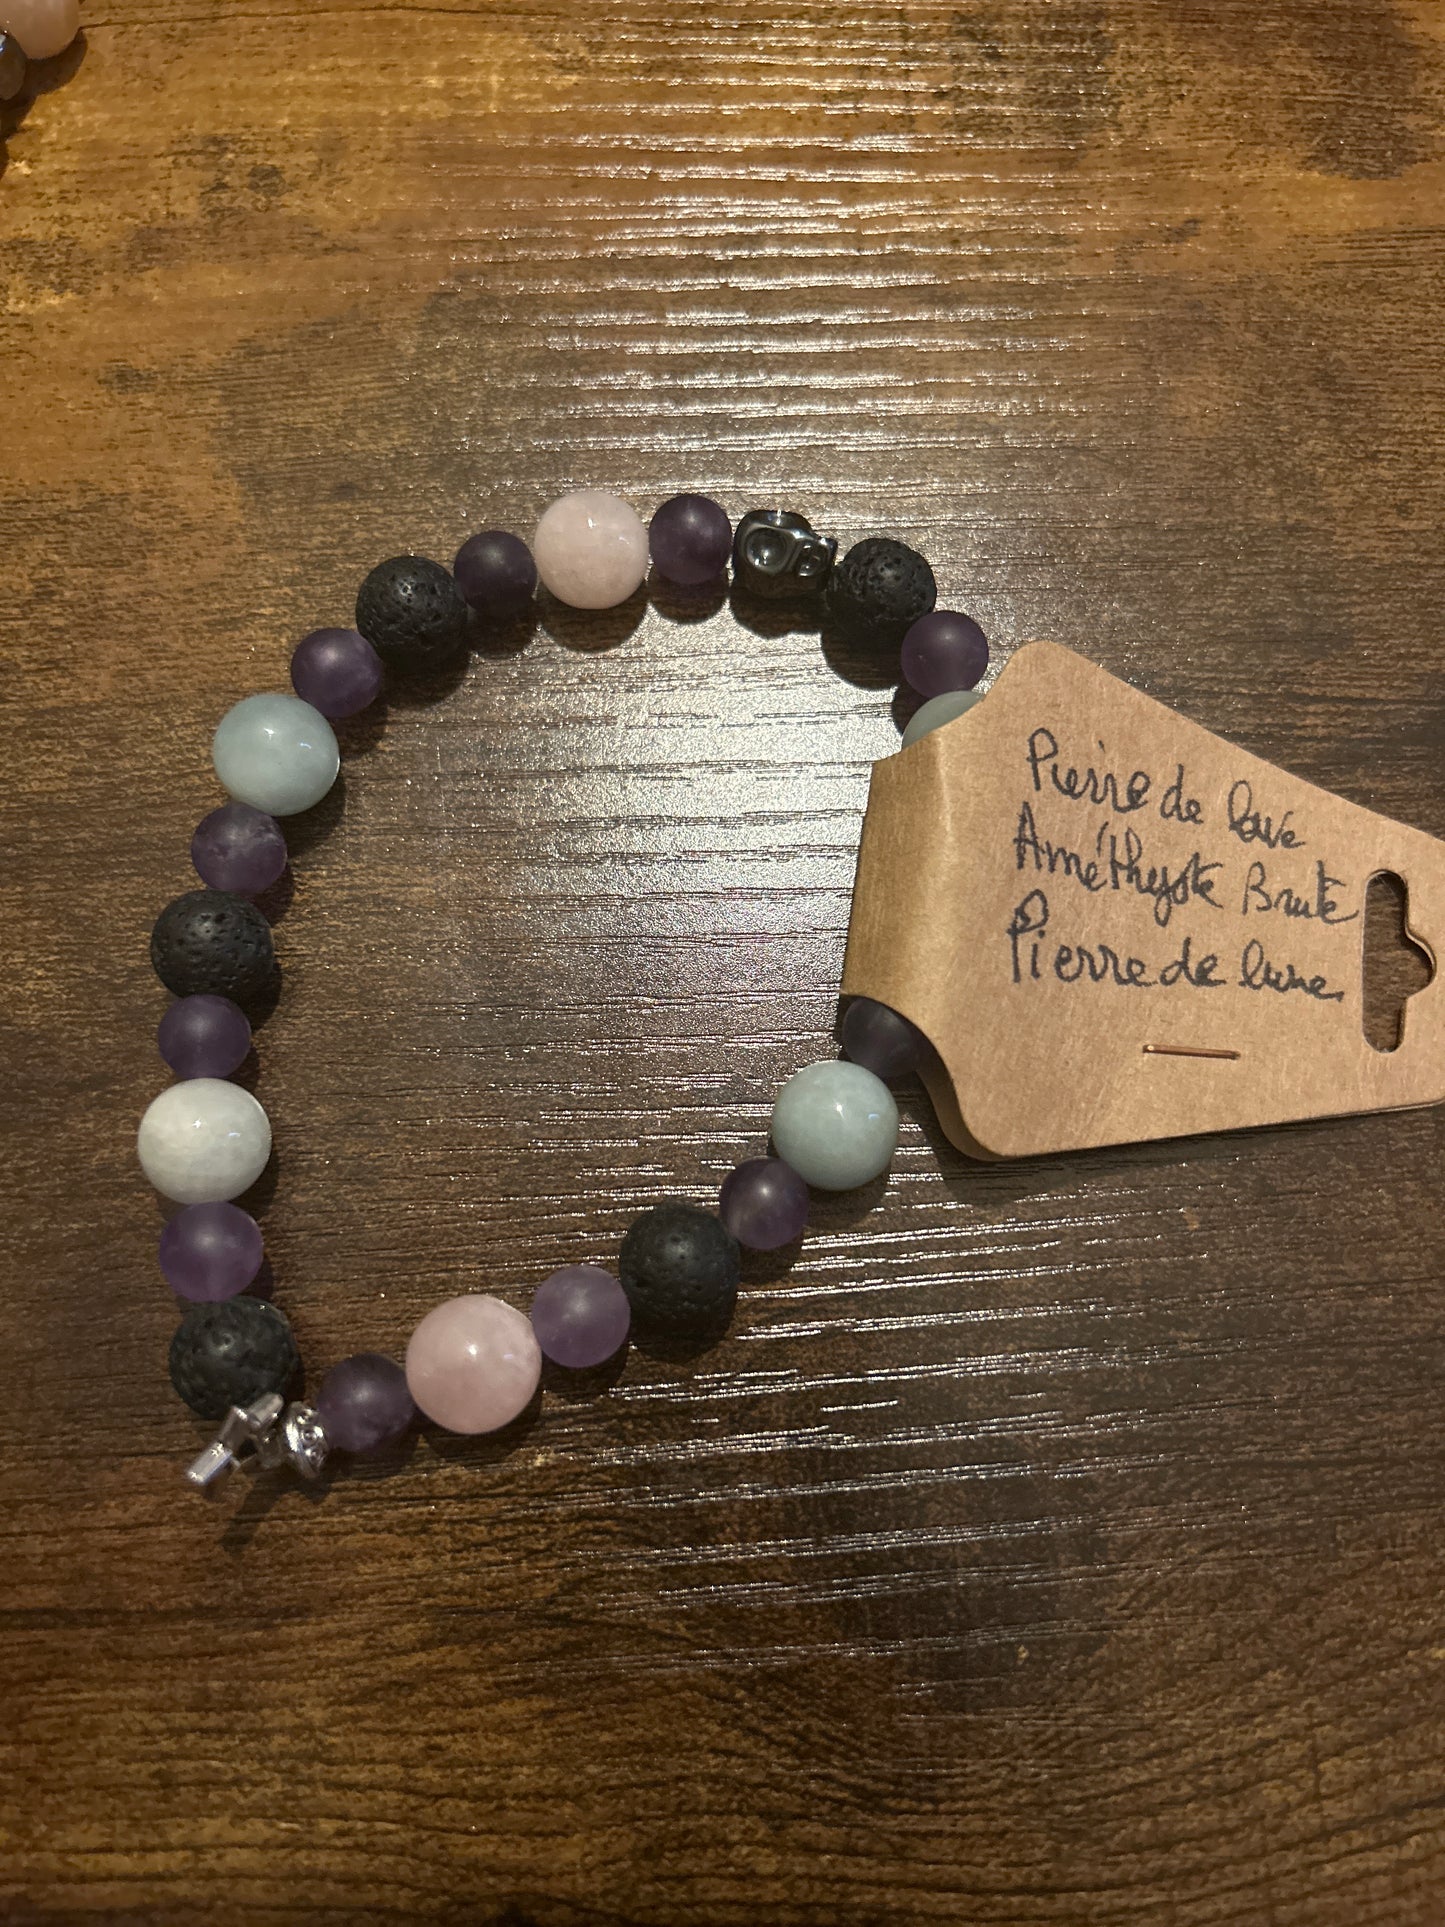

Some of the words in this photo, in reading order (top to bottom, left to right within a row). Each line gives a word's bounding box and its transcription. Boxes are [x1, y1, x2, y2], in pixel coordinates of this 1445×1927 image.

[1027, 727, 1152, 813] Pierre
[1160, 764, 1204, 824] de
[1241, 859, 1360, 925] Brute
[1006, 888, 1153, 984] Pierre
[1159, 937, 1227, 987] de
[1239, 939, 1345, 1002] lune
